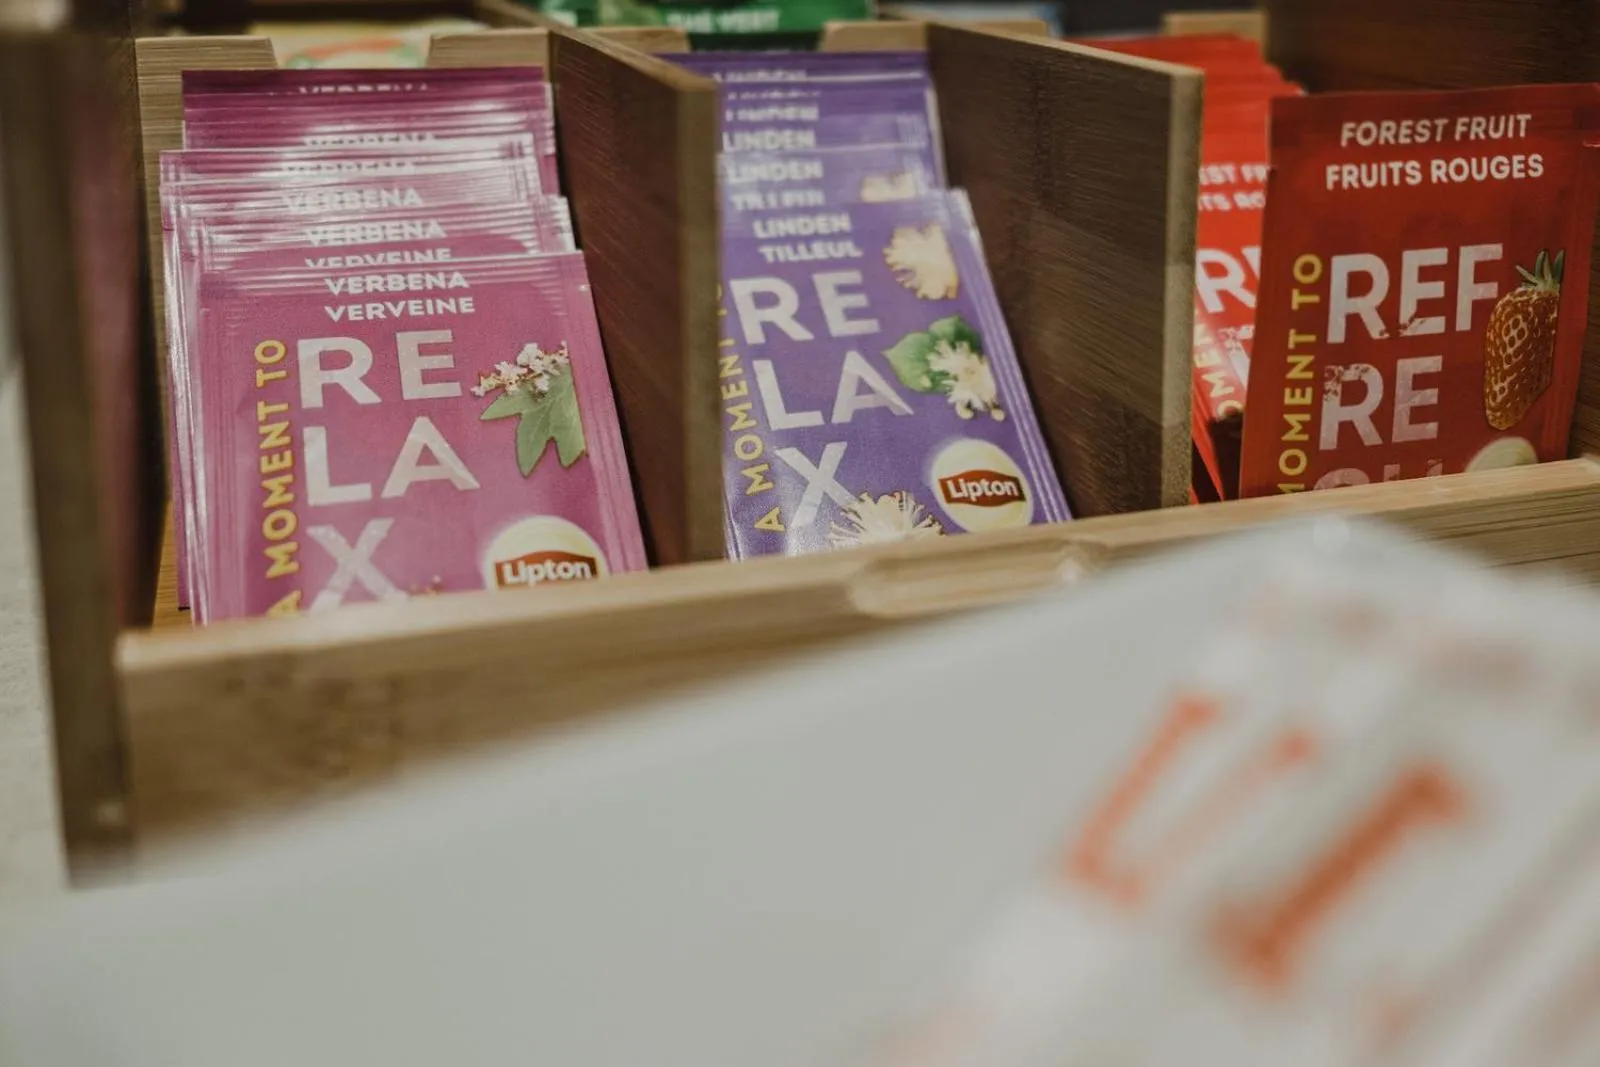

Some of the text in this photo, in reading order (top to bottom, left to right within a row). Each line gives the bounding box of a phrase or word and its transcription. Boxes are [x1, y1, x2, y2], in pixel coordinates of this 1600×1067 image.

[1340, 113, 1532, 147] FOREST FRUIT
[725, 160, 824, 184] LINDEN
[1326, 153, 1544, 190] FRUITS ROUGES
[304, 219, 448, 247] VERBENA
[752, 213, 853, 239] LINDEN
[757, 240, 863, 263] TILLEUL
[323, 271, 470, 296] VERBENA
[1292, 252, 1324, 311] TO
[1328, 243, 1503, 344] REF
[323, 296, 476, 323] VERVEINE
[729, 269, 881, 346] RE
[253, 338, 289, 389] TO
[296, 328, 463, 410] RE
[751, 349, 915, 433] LA
[1318, 354, 1444, 451] RE
[302, 415, 481, 507] LA
[256, 400, 302, 579] MOMENT
[773, 440, 858, 530] X
[944, 475, 1021, 502] Lipton
[753, 506, 787, 533] A
[305, 517, 412, 616] X
[502, 559, 593, 586] Lipton
